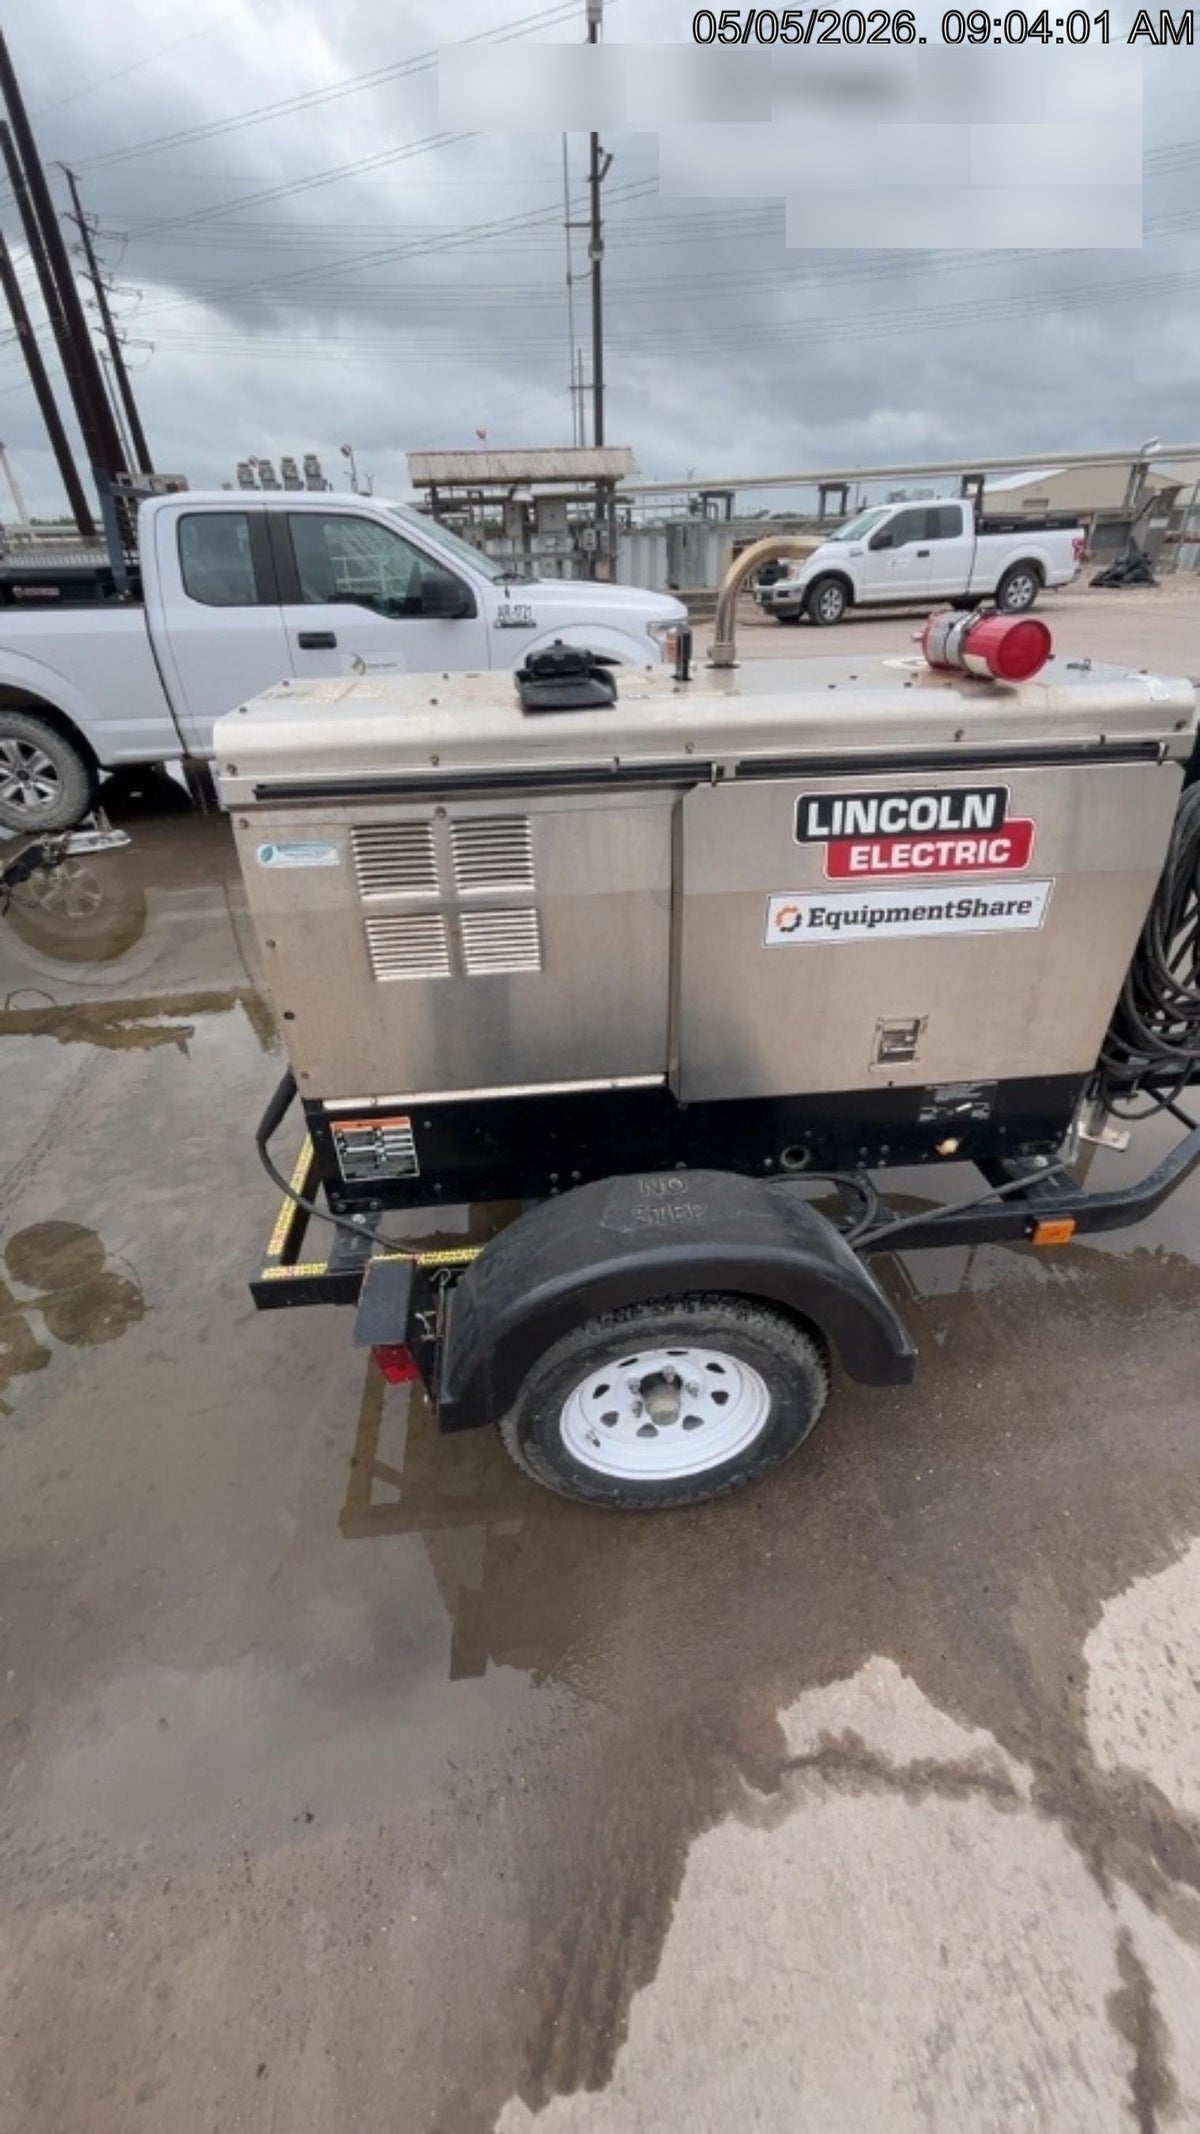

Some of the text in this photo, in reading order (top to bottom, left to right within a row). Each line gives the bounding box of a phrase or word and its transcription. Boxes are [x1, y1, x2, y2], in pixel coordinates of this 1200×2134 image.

[807, 794, 996, 836] LINCOLN
[849, 838, 1012, 871] ELECTRIC
[807, 899, 1032, 929] EquipmentShare
[639, 1177, 687, 1197] NO
